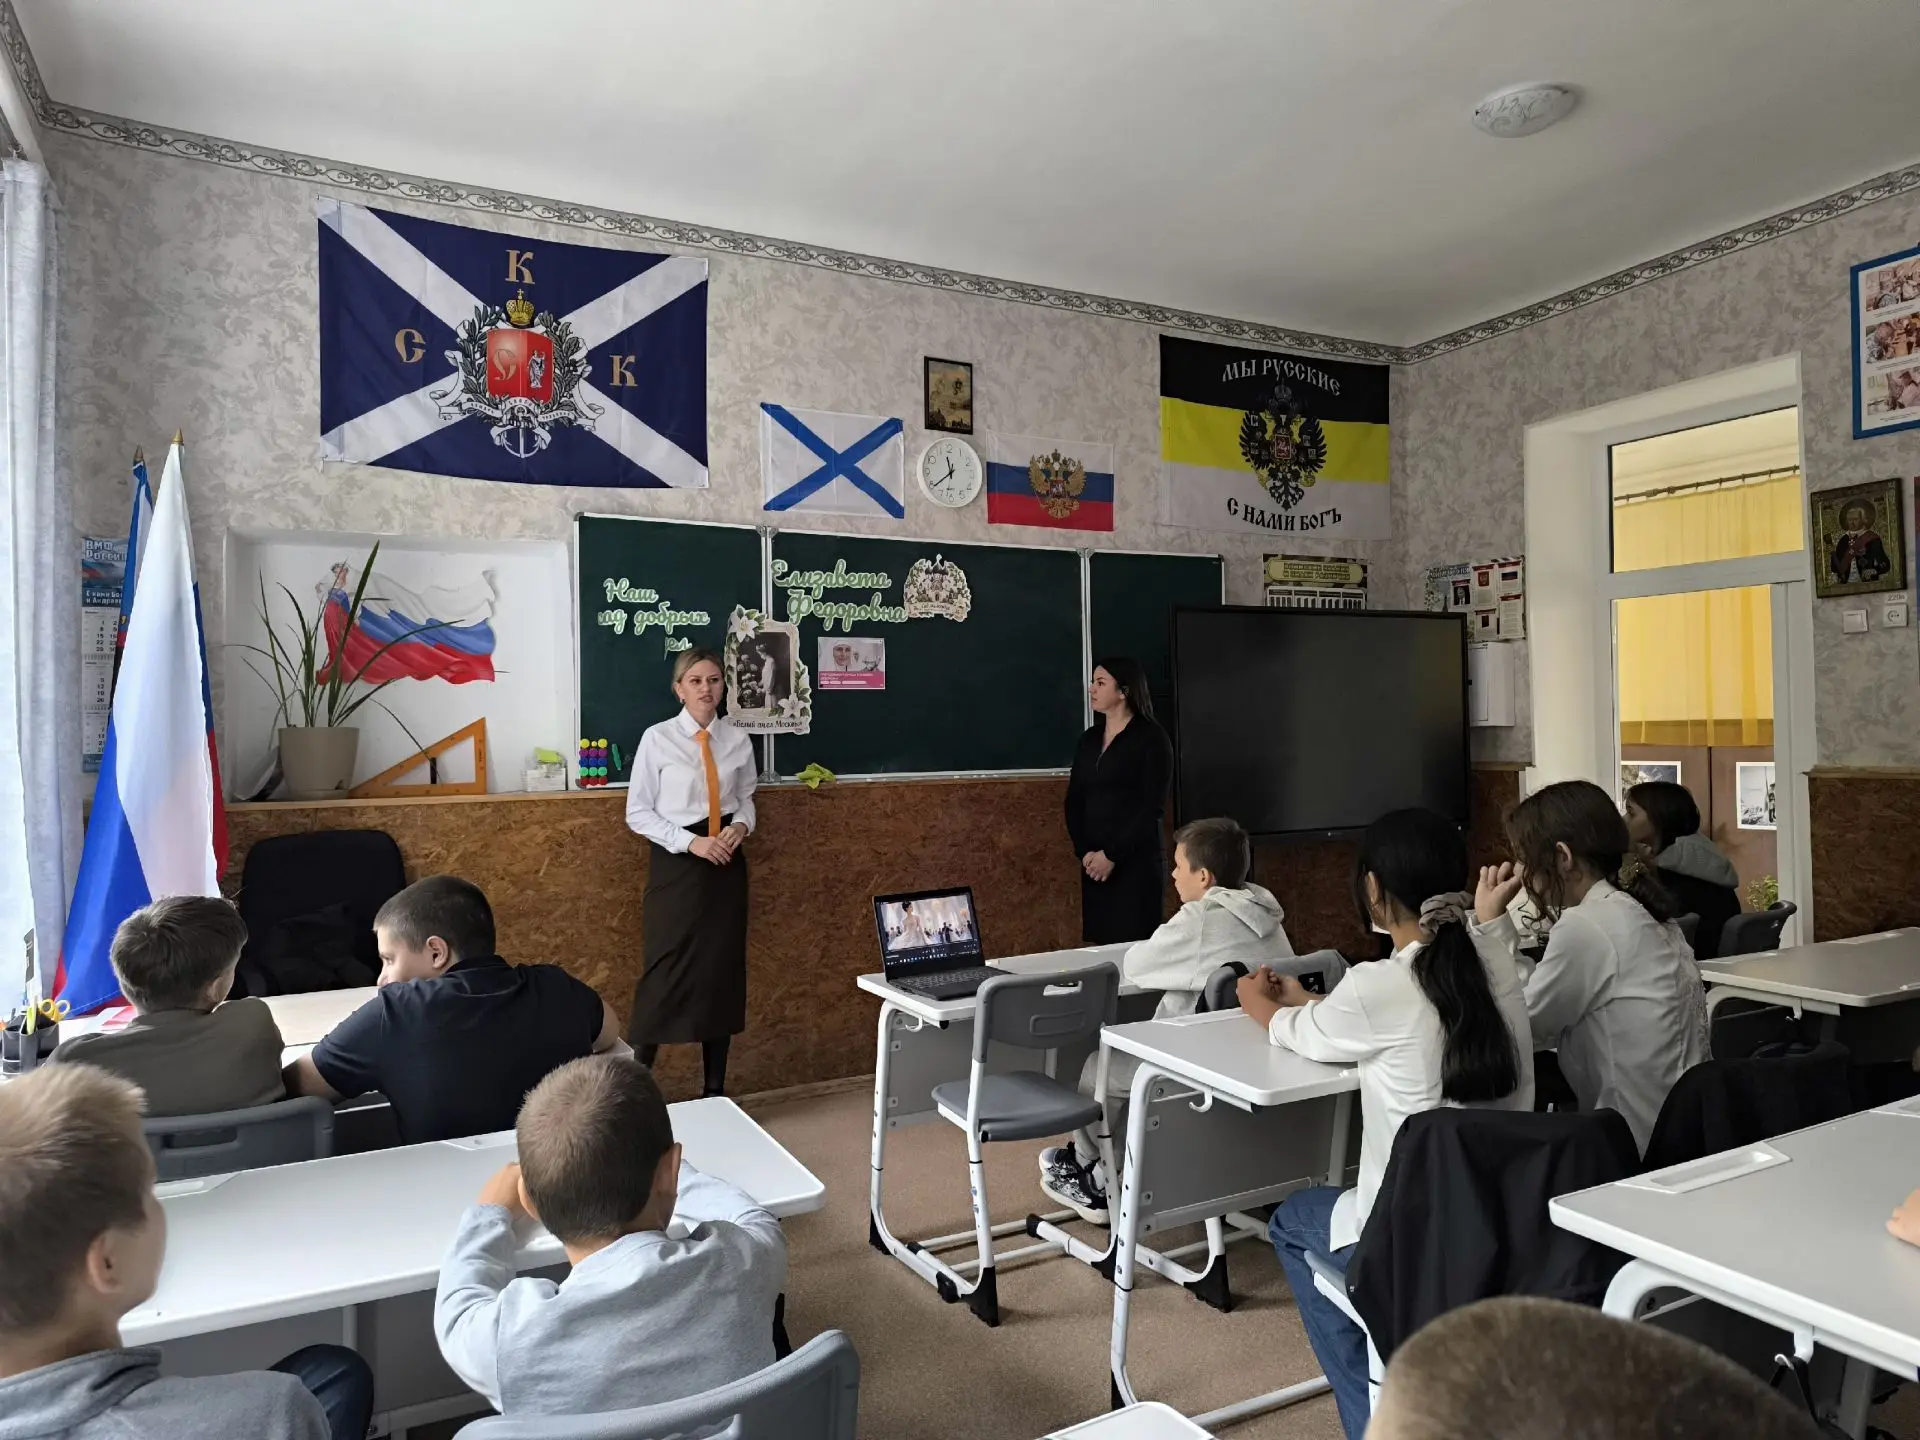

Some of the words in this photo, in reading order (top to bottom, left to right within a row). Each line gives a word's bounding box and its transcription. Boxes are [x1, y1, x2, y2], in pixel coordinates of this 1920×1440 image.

[505, 250, 536, 285] К
[609, 354, 639, 387] К
[1222, 359, 1257, 382] МЫ
[1262, 358, 1340, 396] РУССКИЕ
[1227, 497, 1239, 516] С
[1242, 503, 1295, 531] НАМИ
[1300, 507, 1342, 531] БОГЪ
[603, 578, 659, 603] Наш
[771, 559, 892, 600] Елизавета
[634, 601, 711, 636] добрых
